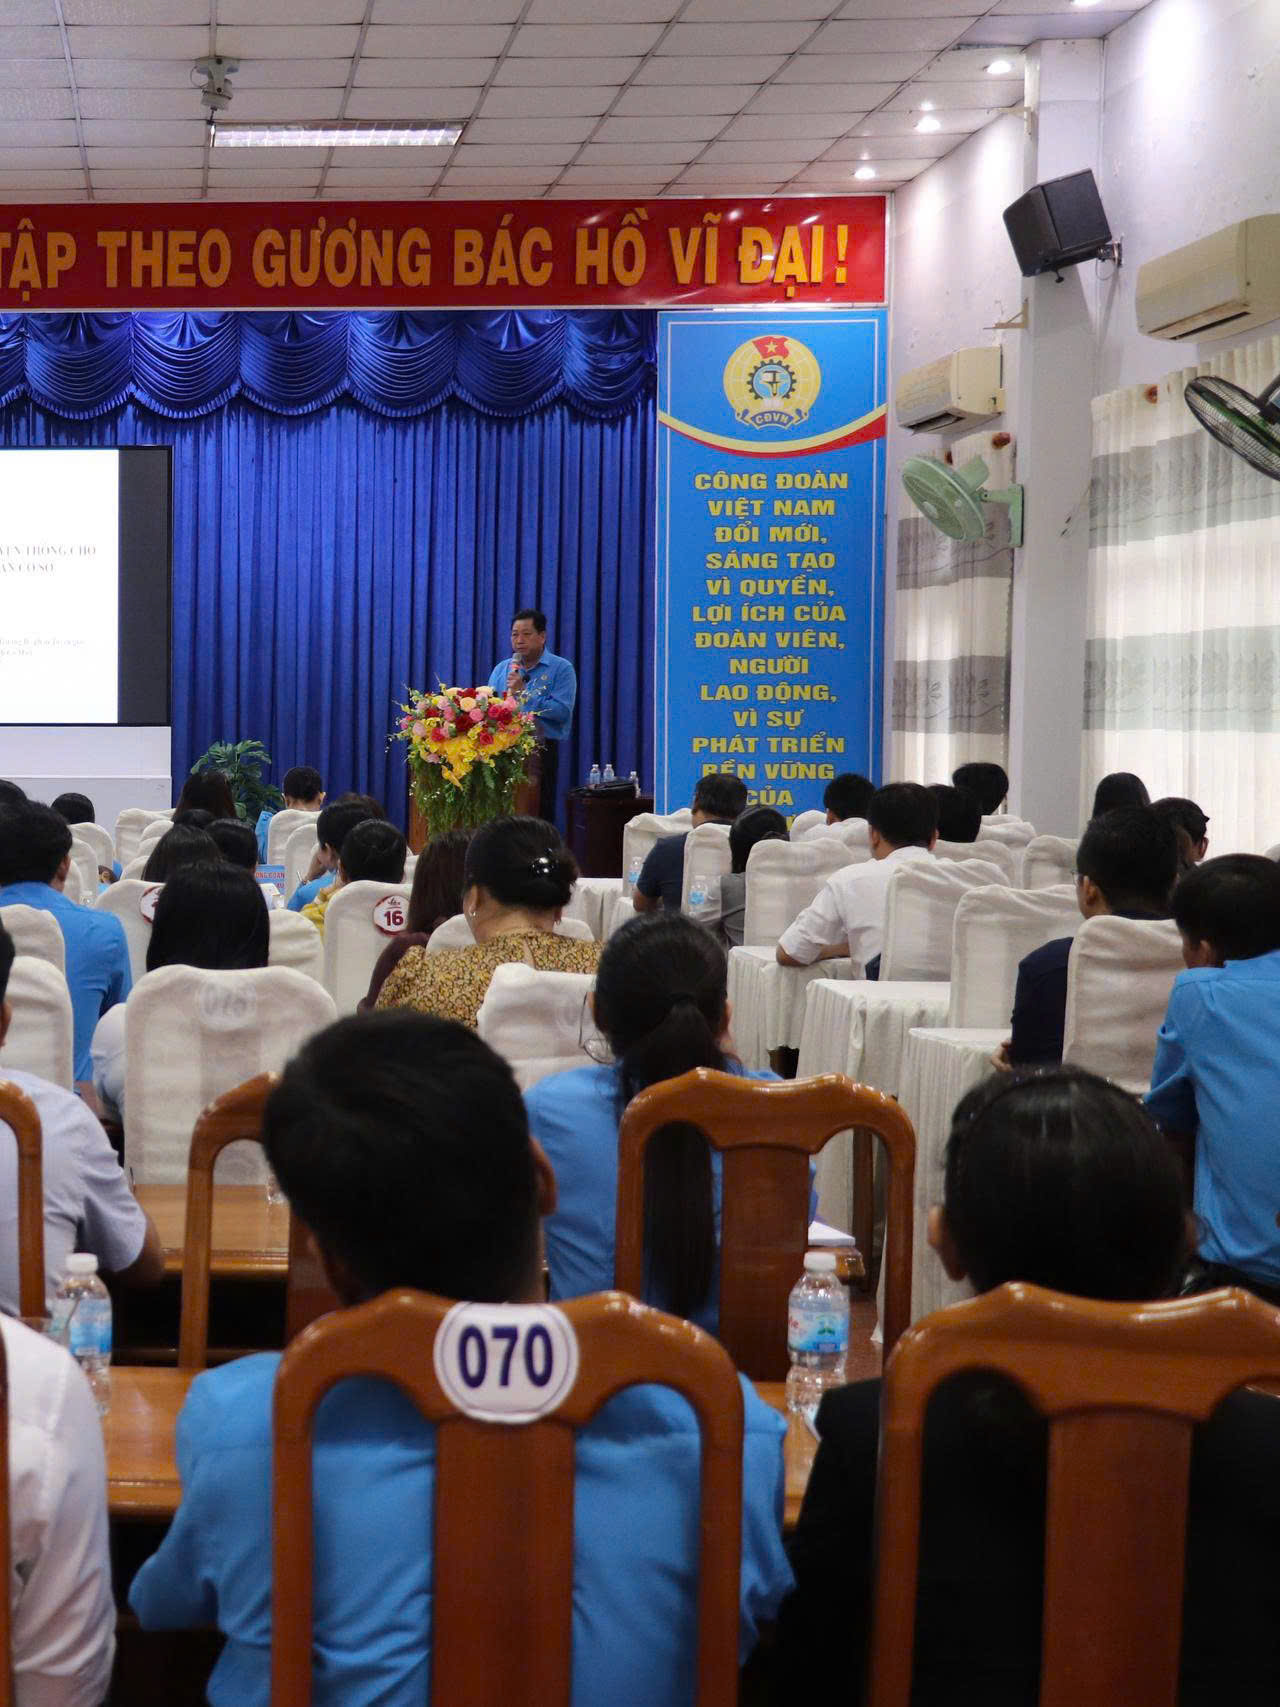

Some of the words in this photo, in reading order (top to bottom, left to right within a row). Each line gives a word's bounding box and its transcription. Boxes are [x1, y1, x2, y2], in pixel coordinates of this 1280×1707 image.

[97, 229, 232, 288] THEO
[252, 216, 431, 288] GƯƠNG
[453, 213, 553, 287] BÁC
[575, 207, 648, 286] HỒ
[668, 213, 721, 285] VĨ
[694, 471, 768, 489] CÔNG
[775, 469, 848, 489] ĐOÀN
[707, 498, 764, 519] VIỆT
[773, 499, 835, 516] NAM
[714, 520, 759, 542] ĐỔI
[706, 550, 777, 569] SÁNG
[787, 552, 835, 572] TẠO
[706, 576, 730, 595] VÌ
[692, 603, 731, 625] LỢI
[741, 602, 785, 621] ÍCH
[794, 601, 847, 621] CỦA
[695, 628, 766, 648] ĐOÀN
[729, 655, 809, 675] NGƯỜI
[700, 684, 748, 701] LAO
[733, 708, 758, 727] VÌ
[766, 708, 804, 729] SỰ
[692, 735, 759, 753] PHÁT
[767, 731, 845, 753] TRIỂN
[764, 760, 835, 780] VỮNG
[384, 910, 404, 926] 16
[458, 1324, 553, 1389] 070
